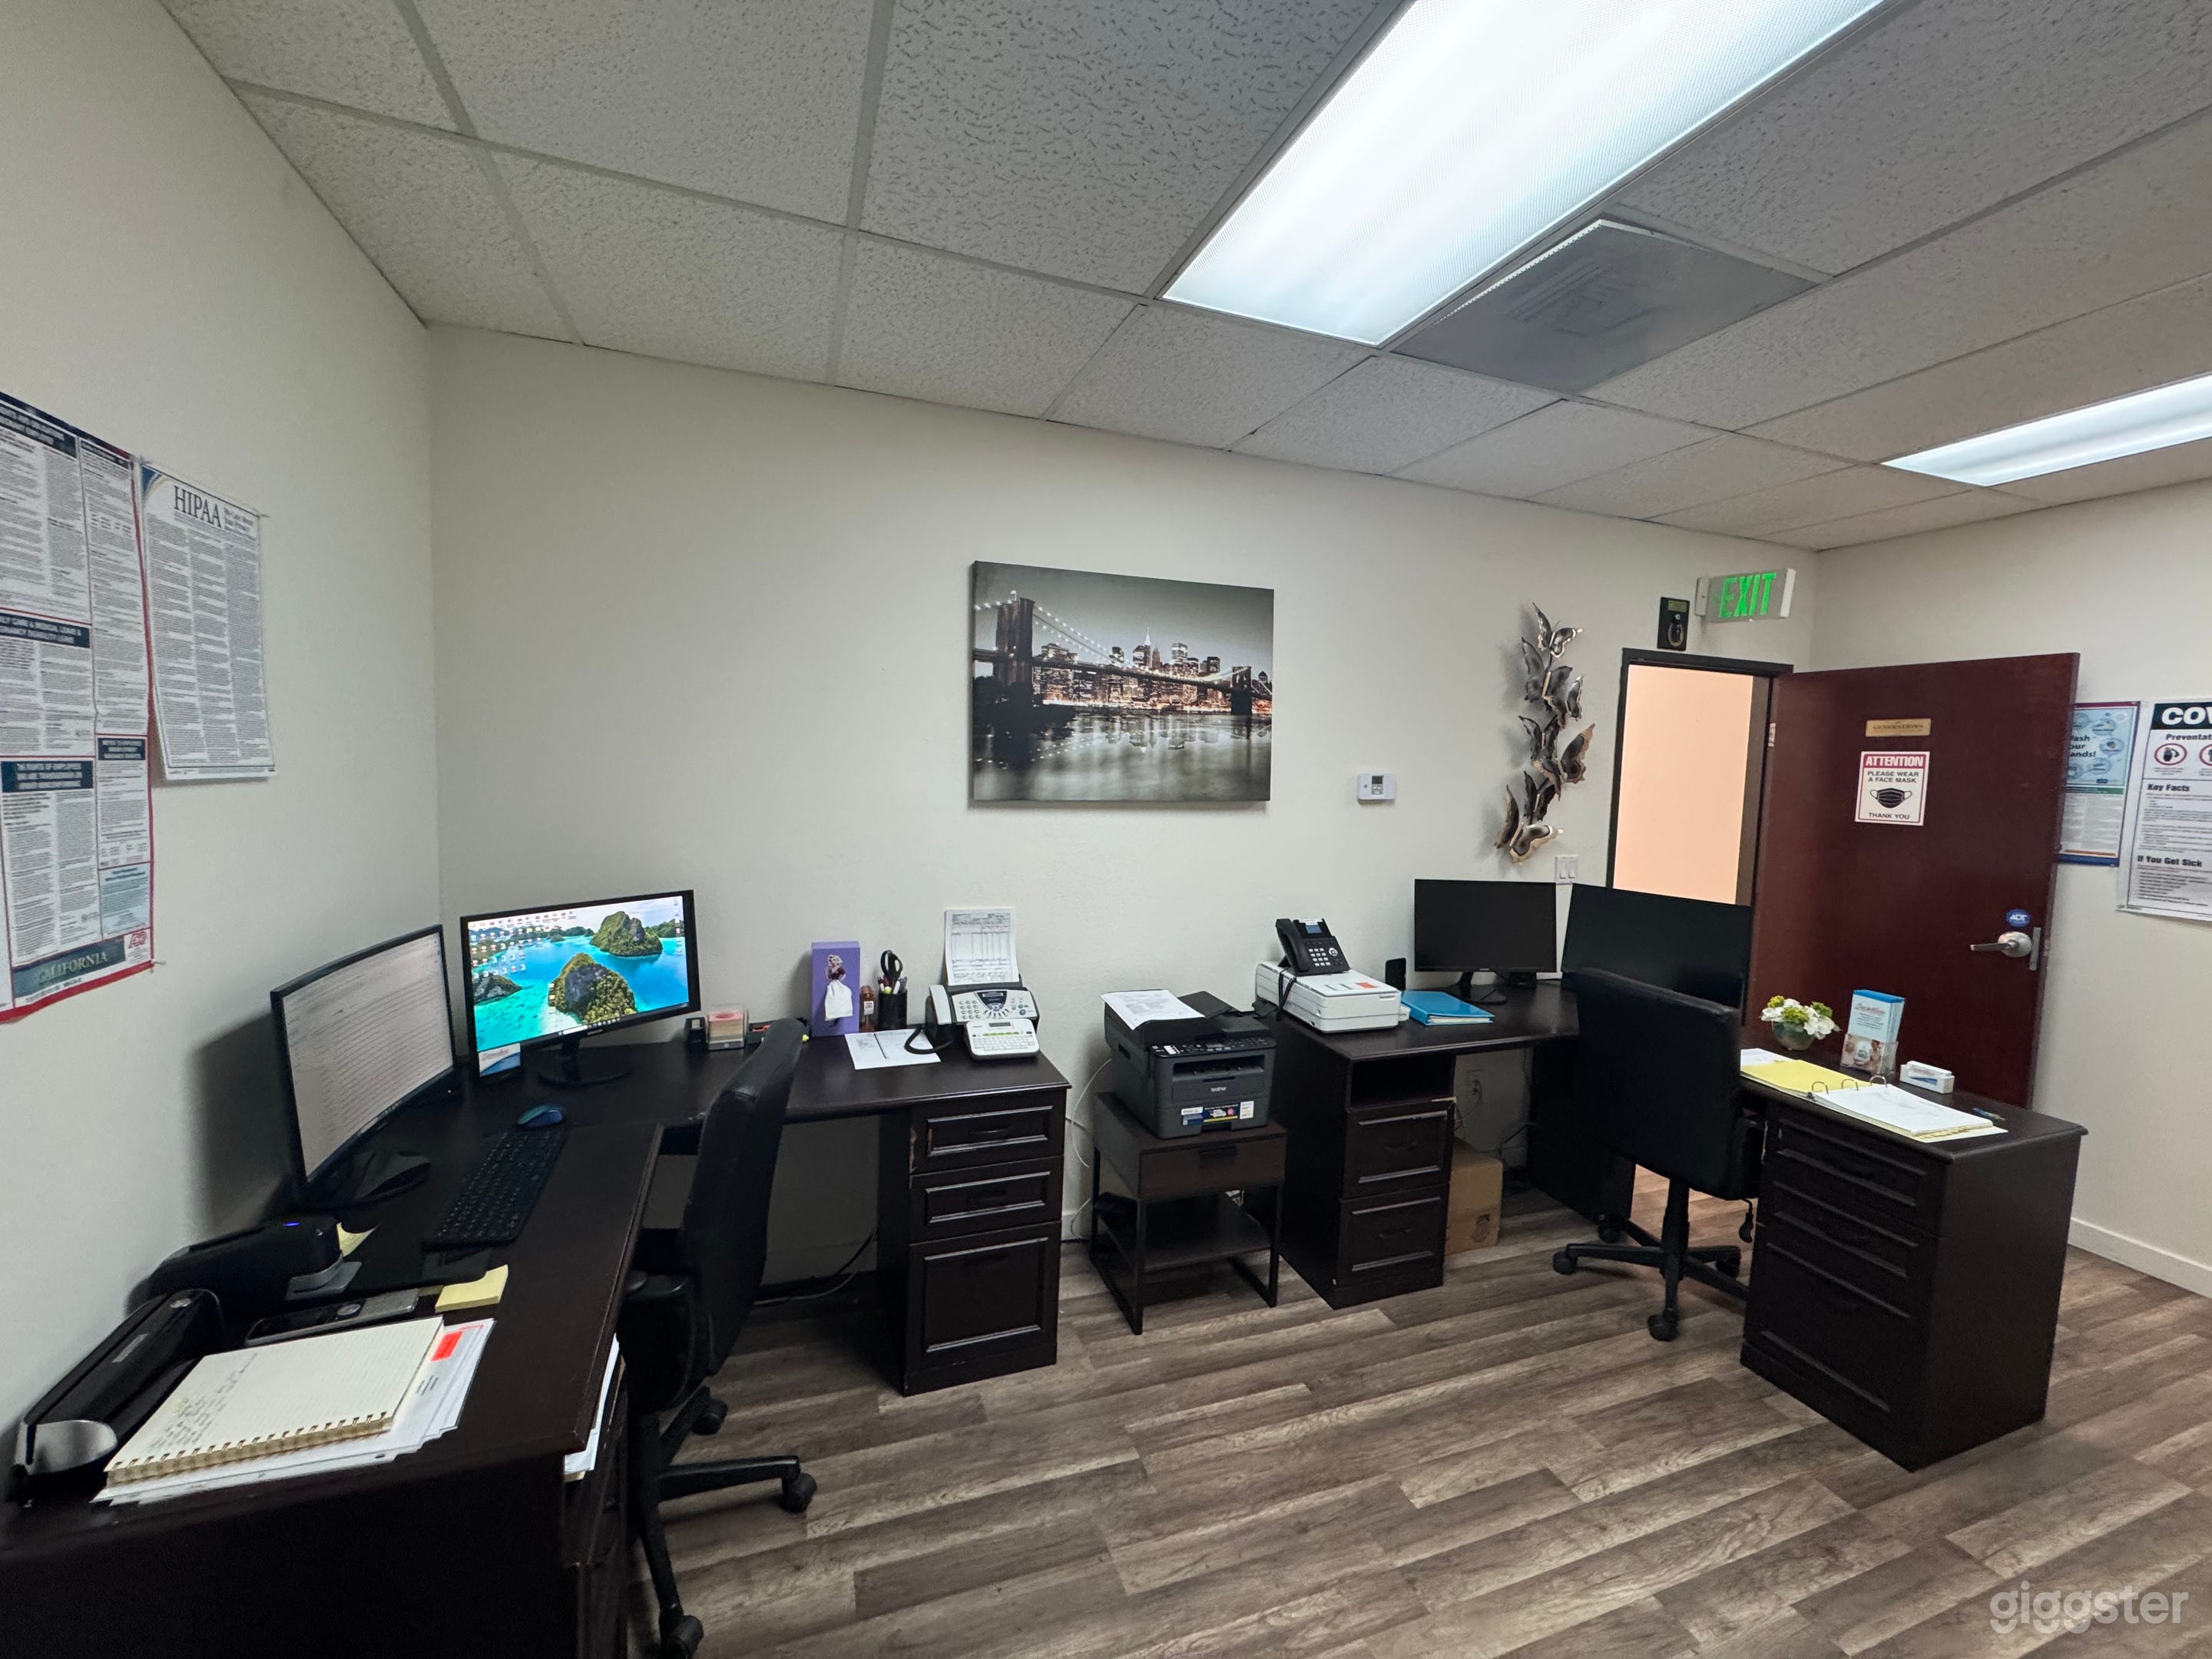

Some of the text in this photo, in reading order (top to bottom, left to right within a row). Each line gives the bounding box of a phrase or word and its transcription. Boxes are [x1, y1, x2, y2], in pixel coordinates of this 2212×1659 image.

[174, 485, 221, 528] HIPAA
[1719, 572, 1777, 618] EXIT
[1865, 756, 1923, 767] ATTENTION
[2147, 783, 2164, 792] Key
[2164, 857, 2180, 866] Get
[2182, 859, 2202, 867] Sick
[38, 952, 108, 981] CALIFORNIA
